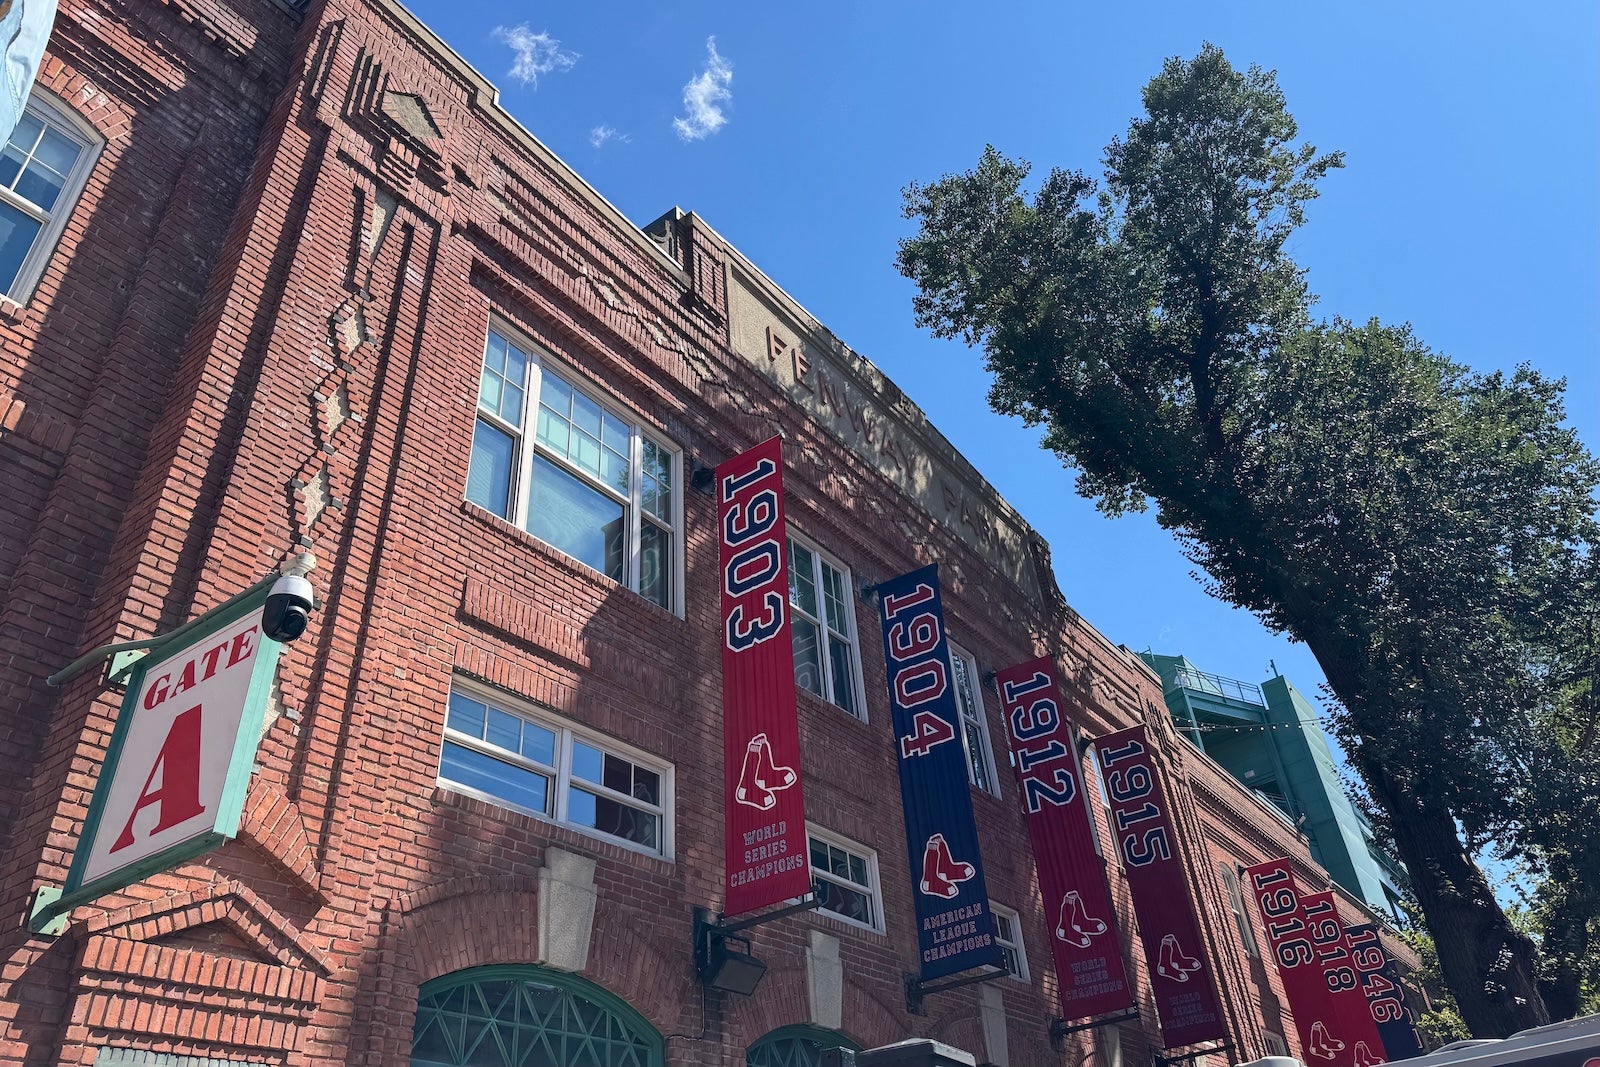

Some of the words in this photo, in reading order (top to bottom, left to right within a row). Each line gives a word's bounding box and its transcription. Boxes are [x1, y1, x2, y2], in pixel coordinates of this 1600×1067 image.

[723, 458, 785, 653] 1903
[143, 624, 259, 711] GATE
[884, 582, 956, 759] 1904
[108, 703, 206, 855] A
[1003, 671, 1077, 814] 1912
[742, 820, 788, 847] WORLD
[1101, 739, 1172, 867] 1915
[730, 853, 804, 888] CHAMPIONS
[744, 839, 788, 864] SERIES
[923, 902, 983, 931] AMERICAN
[923, 933, 992, 963] CHAMPIONS
[932, 921, 977, 944] LEAGUE
[1253, 867, 1315, 968] 1916
[1302, 900, 1358, 993] 1918
[1345, 929, 1403, 1023] 1946
